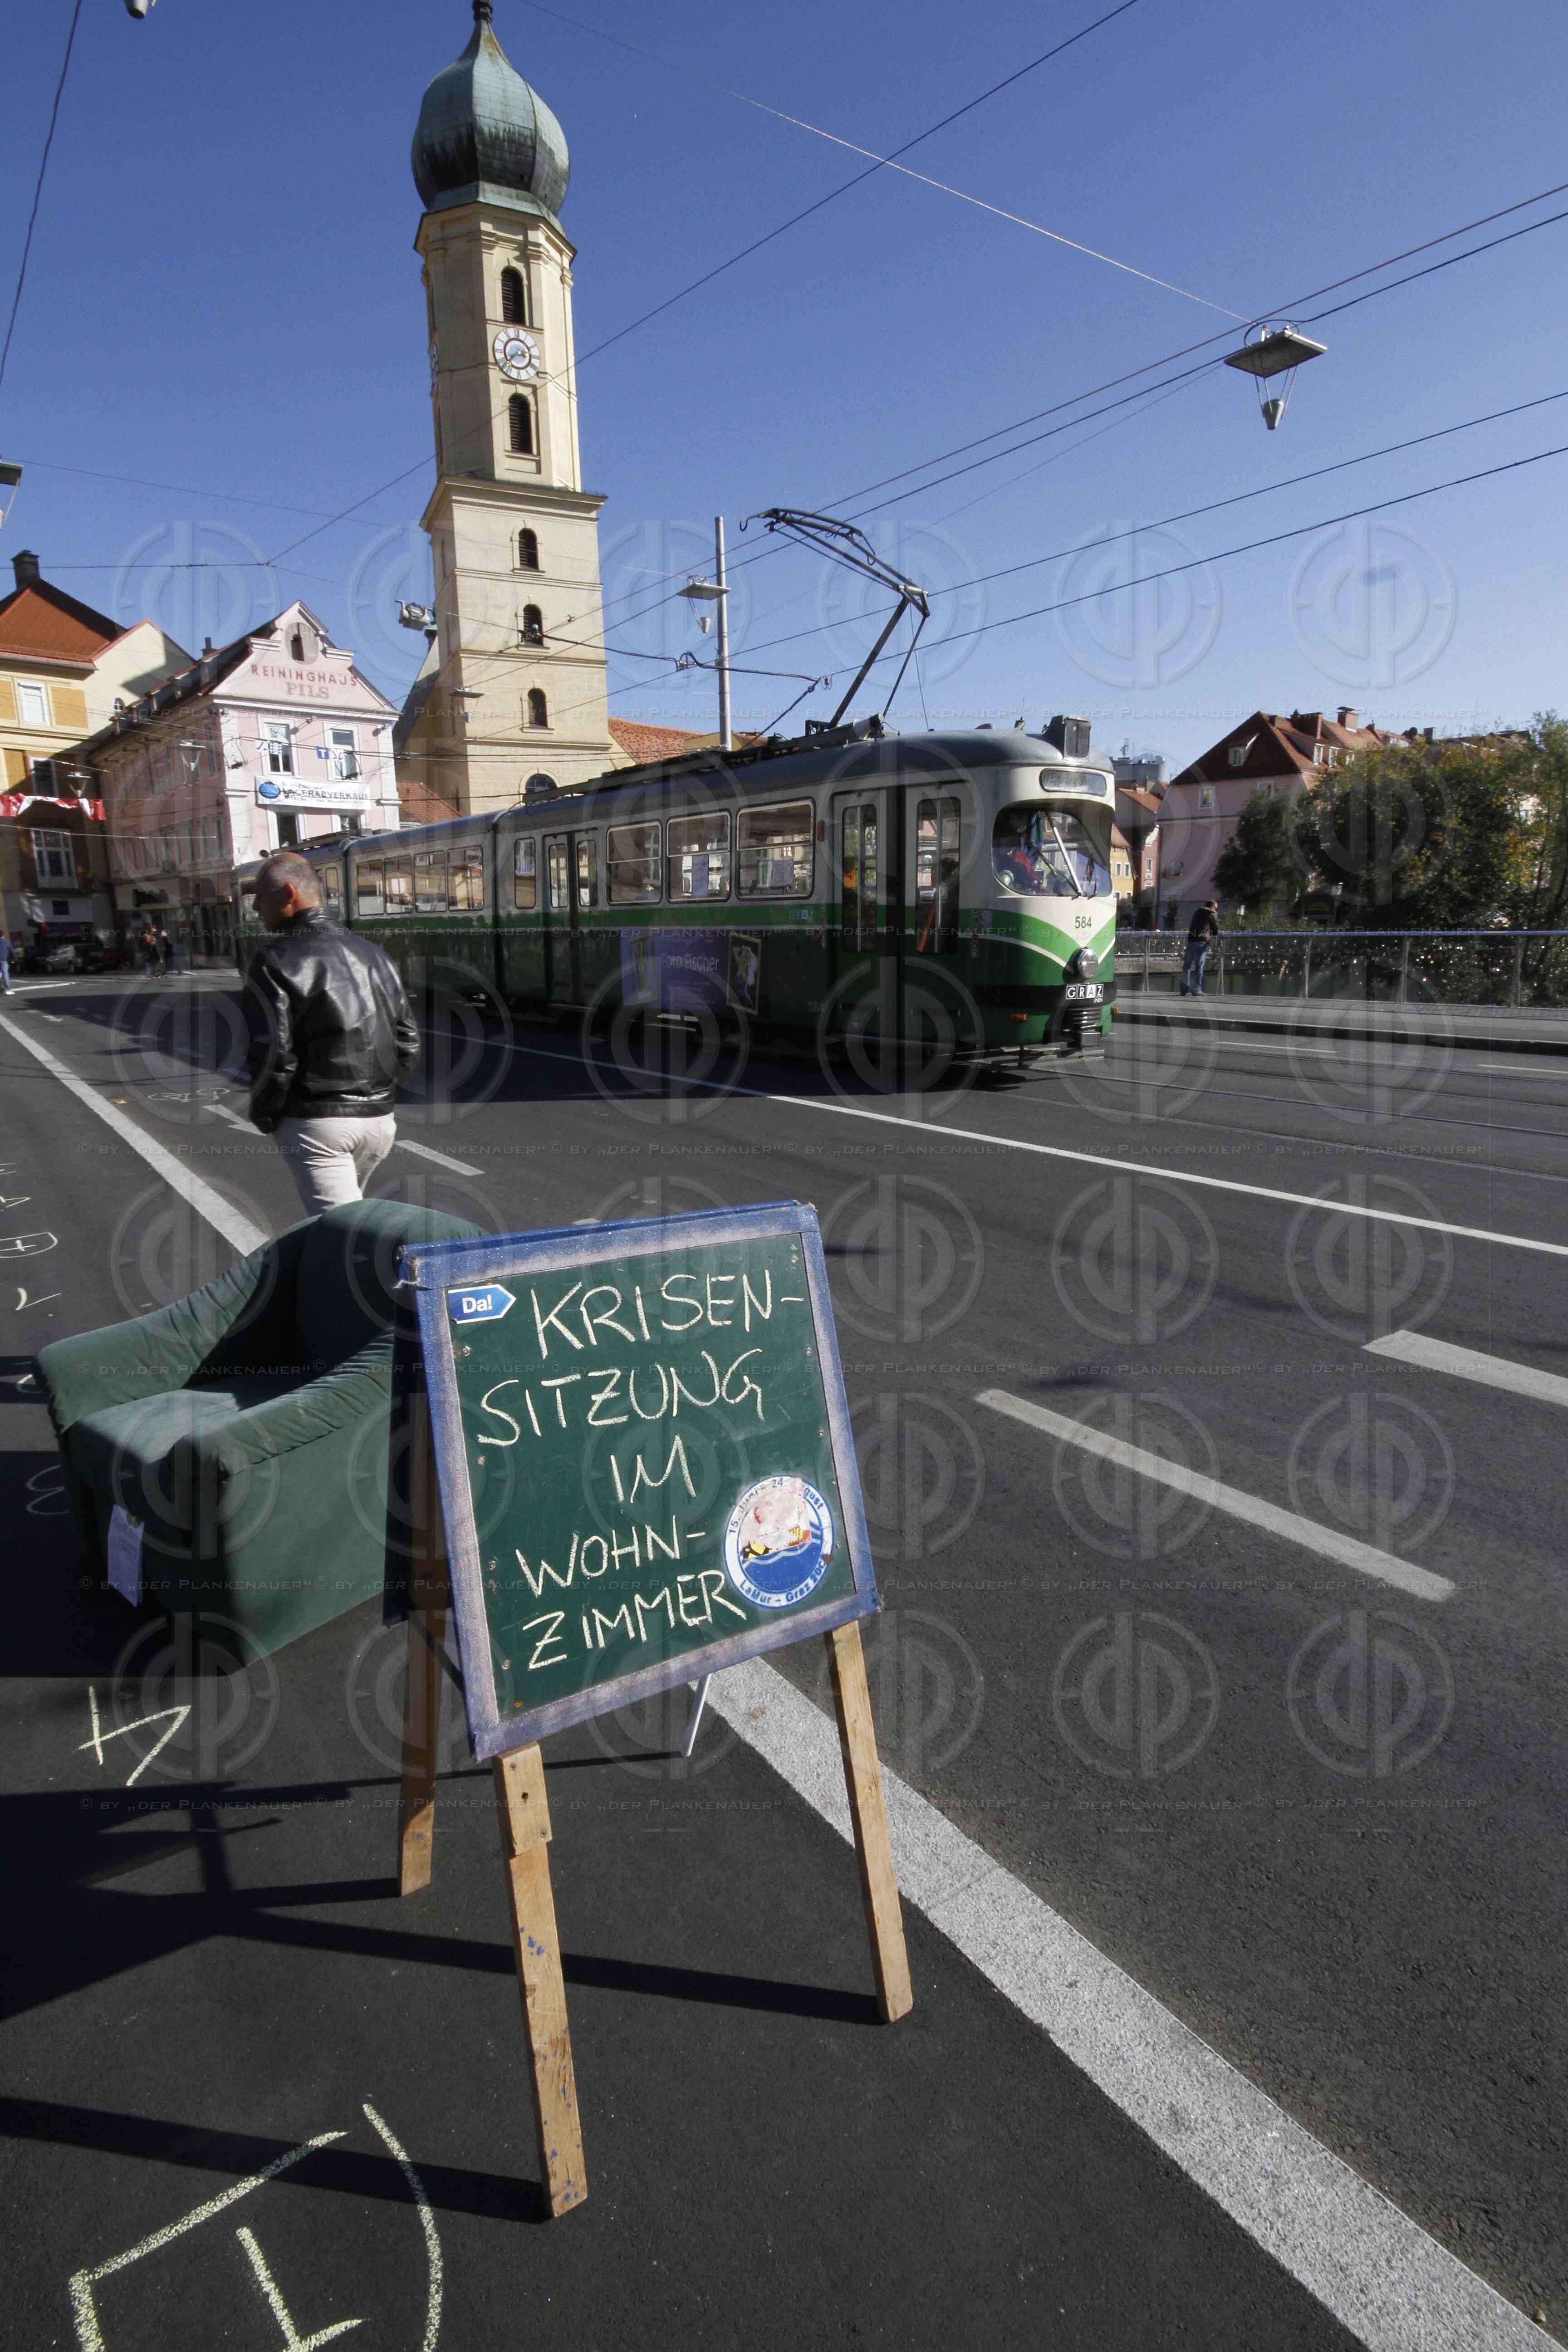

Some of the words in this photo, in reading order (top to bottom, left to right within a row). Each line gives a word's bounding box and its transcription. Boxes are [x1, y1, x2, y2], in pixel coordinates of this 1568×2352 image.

[251, 664, 357, 686] REININGHAUS
[286, 682, 329, 699] PILS
[1074, 916, 1092, 929] 584
[684, 953, 719, 972] Fischer
[1067, 985, 1103, 998] GRAZ
[462, 1294, 493, 1314] Da!
[530, 1269, 804, 1360] KRISEN-
[477, 1348, 767, 1447] SITZUNG
[610, 1434, 697, 1504] IM
[515, 1514, 706, 1599] WOHN-
[522, 1569, 746, 1671] ZIMMER
